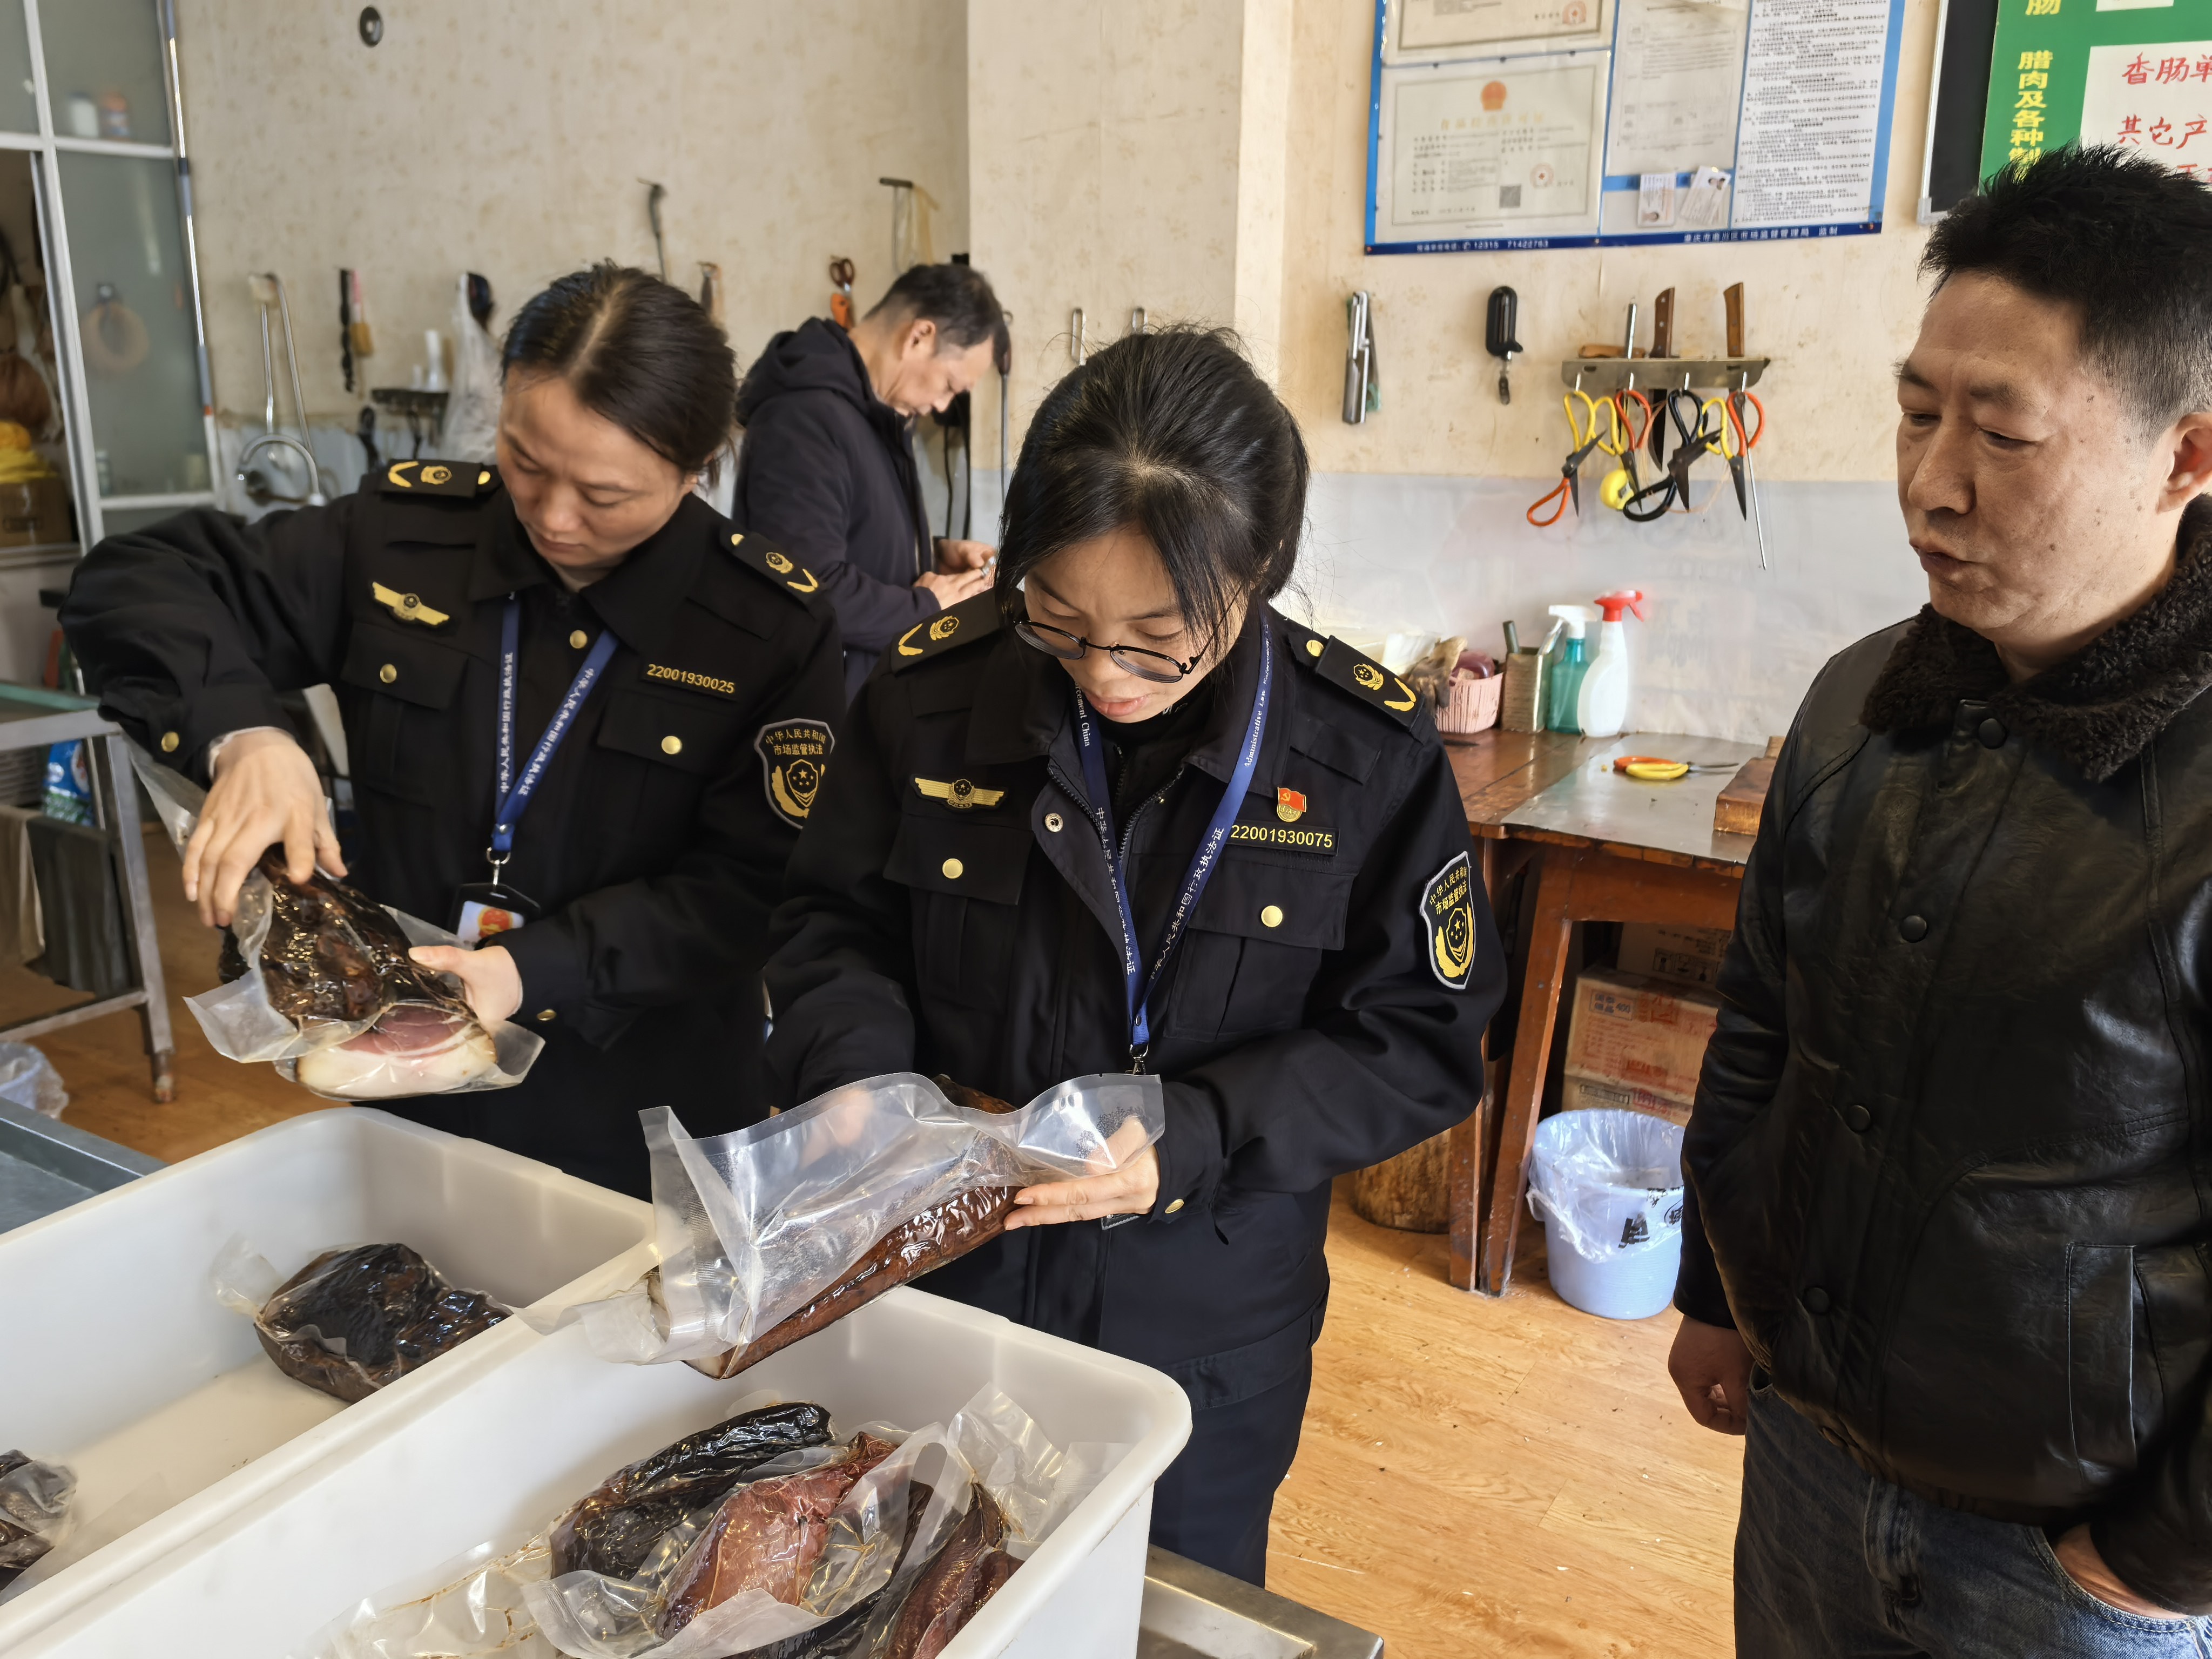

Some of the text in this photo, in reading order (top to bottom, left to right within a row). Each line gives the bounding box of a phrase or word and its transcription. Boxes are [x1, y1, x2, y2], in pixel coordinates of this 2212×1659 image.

[2008, 50, 2053, 184] 腊肉及各种制
[2117, 113, 2208, 149] 其它产
[647, 664, 736, 693] 22001930025
[1075, 682, 1091, 747] orcement China
[765, 729, 826, 745] 中华人民共和国
[773, 743, 823, 756] 市场监管执法
[1244, 710, 1263, 767] Administrative
[1230, 825, 1333, 848] 22001930075
[1150, 827, 1224, 980] 中华人民共和国行政执法证
[1435, 879, 1467, 915] 市场监管执法
